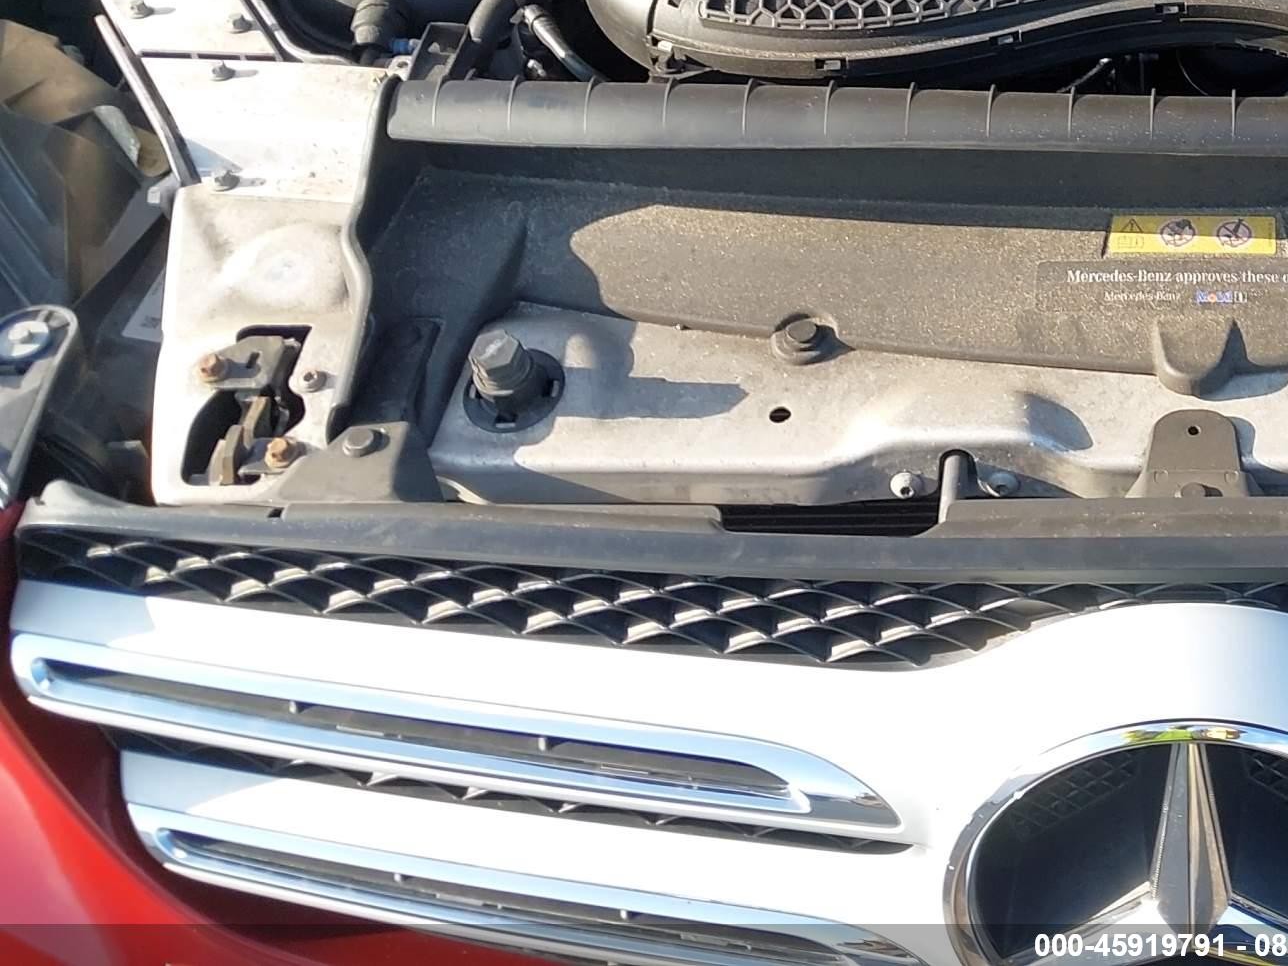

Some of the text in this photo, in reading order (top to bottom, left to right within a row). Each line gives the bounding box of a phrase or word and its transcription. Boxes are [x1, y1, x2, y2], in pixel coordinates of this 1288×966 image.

[1066, 269, 1172, 283] Mercedes-Benz
[1175, 271, 1239, 285] approves
[1242, 270, 1280, 283] these
